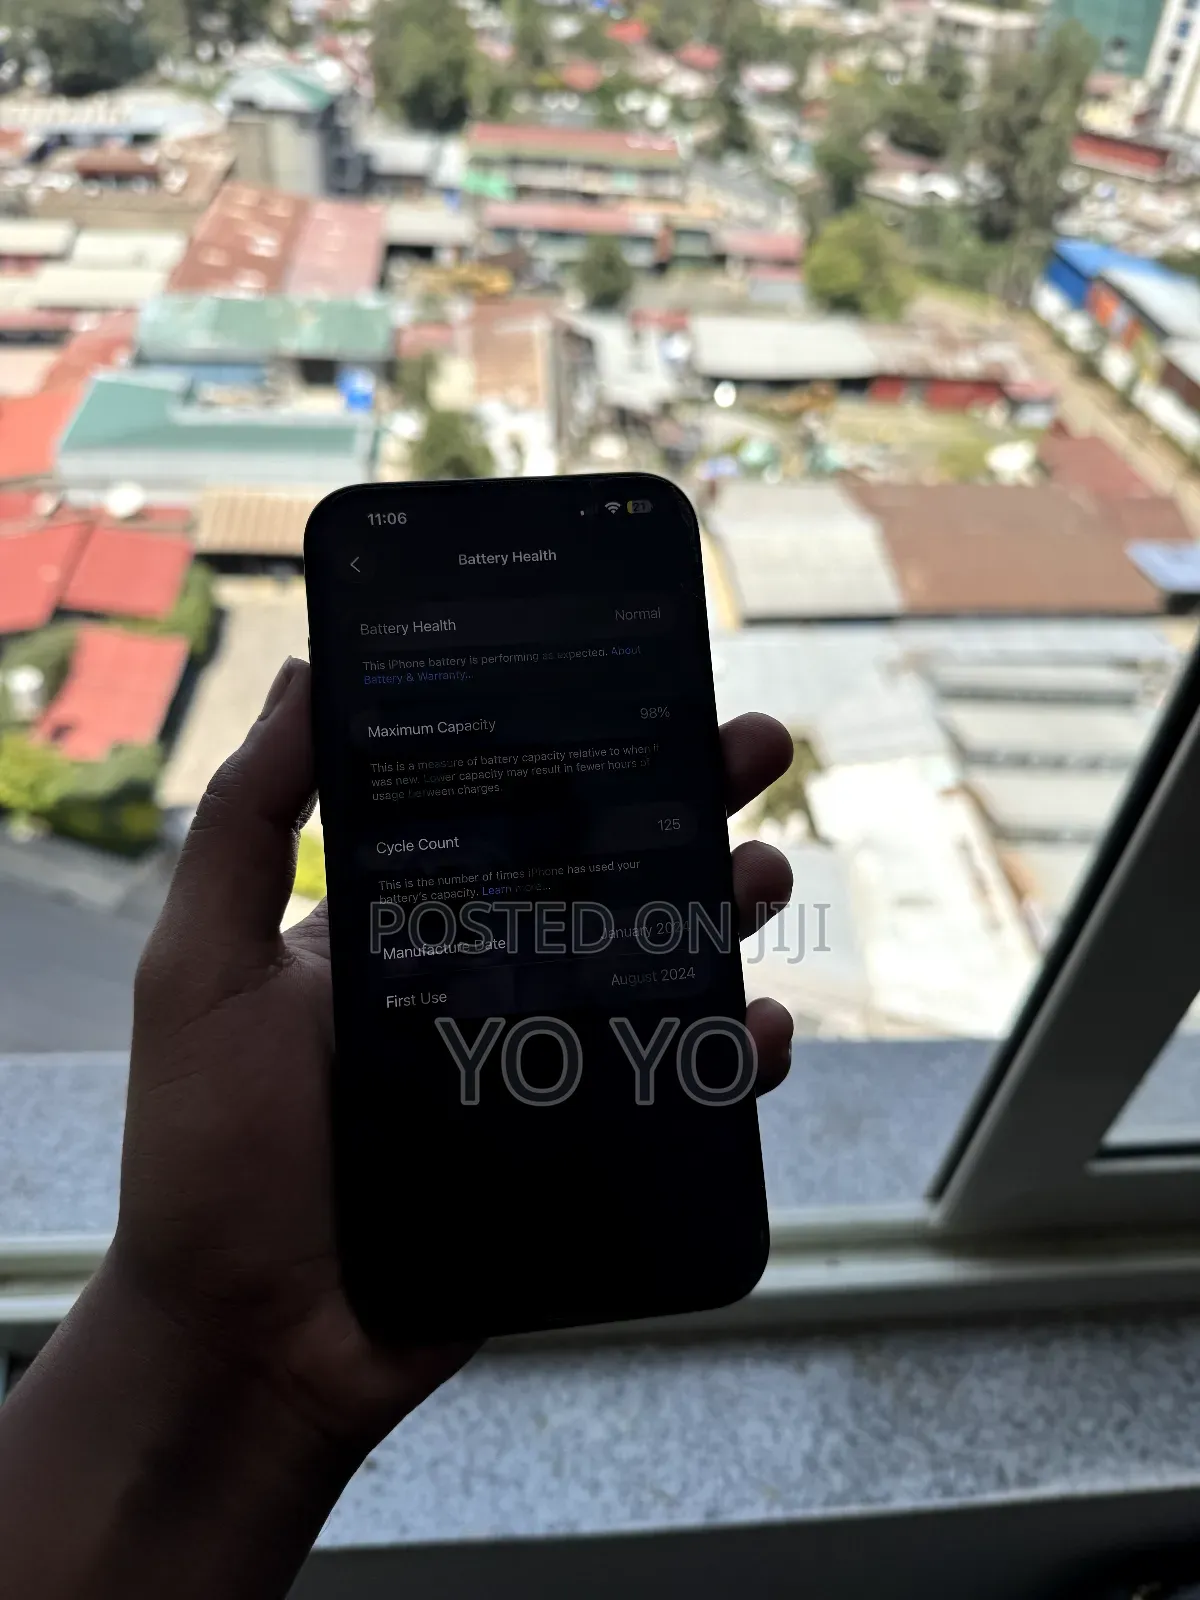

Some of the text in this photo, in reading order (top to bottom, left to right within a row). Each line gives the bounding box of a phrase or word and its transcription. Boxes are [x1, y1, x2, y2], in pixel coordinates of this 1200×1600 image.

[367, 512, 408, 526] 11:06
[458, 549, 557, 566] Battery Health
[615, 606, 661, 622] Normal
[360, 618, 456, 636] Battery Health
[363, 645, 641, 671] This iPhone battery is performing as expected. About
[363, 673, 402, 686] Battery
[406, 672, 414, 682] &
[640, 705, 671, 719] 98%
[368, 718, 496, 738] Maximum Capacity
[370, 763, 393, 773] This
[396, 762, 405, 771] is
[408, 763, 415, 771] a
[418, 759, 464, 770] measure
[467, 756, 478, 766] of
[480, 753, 518, 766] battery
[521, 751, 565, 764] capacity
[568, 747, 606, 759] relative
[608, 748, 620, 758] to
[622, 744, 650, 756] when
[371, 777, 391, 787] was
[459, 768, 503, 783] capacity
[506, 768, 529, 779] may
[532, 764, 561, 776] result
[564, 764, 573, 773] in
[576, 761, 604, 772] fewer
[607, 759, 637, 770] hours
[372, 789, 405, 802] usage
[457, 783, 503, 797] charges.
[657, 818, 681, 831] 125
[376, 836, 460, 856] Cycle Count
[378, 861, 641, 891] This is the number of times iPhone has used your
[431, 888, 479, 902] capacity.
[482, 885, 512, 896] Learn
[600, 920, 691, 941] January 2024
[383, 937, 506, 961] Manufacture Date
[611, 967, 696, 987] August 2024
[386, 991, 447, 1009] First Use
